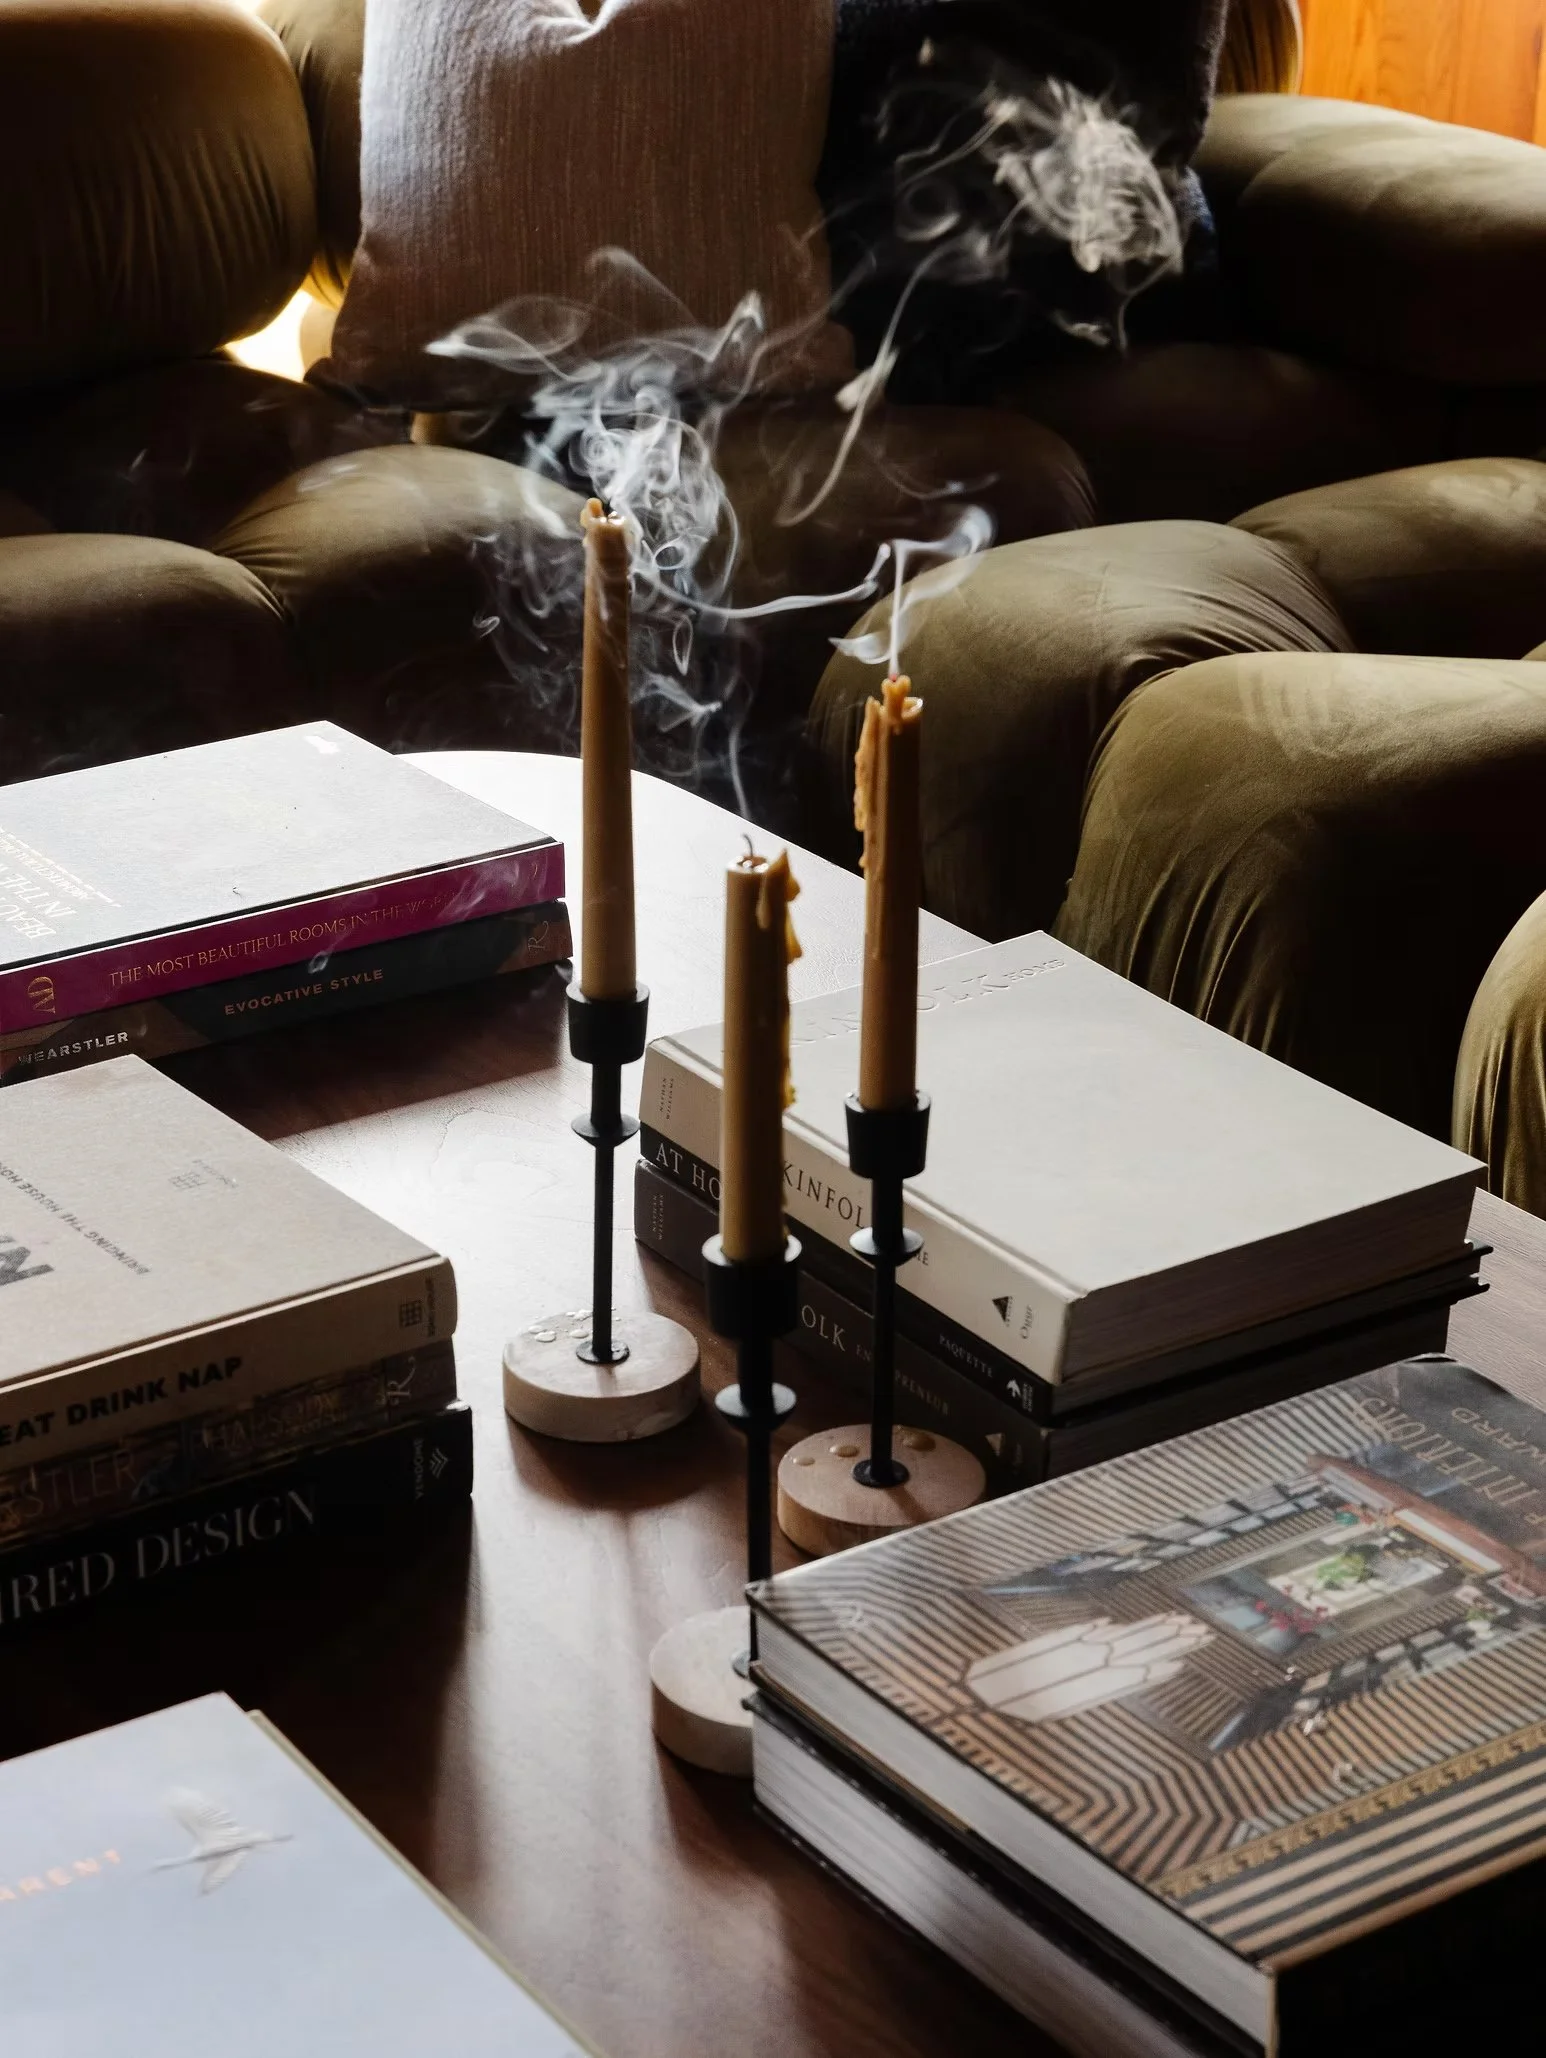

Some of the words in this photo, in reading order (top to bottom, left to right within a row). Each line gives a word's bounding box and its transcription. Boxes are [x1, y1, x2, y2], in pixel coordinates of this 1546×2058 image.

[109, 966, 144, 986] THE
[147, 954, 194, 977] MOST
[198, 932, 287, 967] BEAUTIFUL
[290, 918, 348, 947] ROOMS
[224, 984, 322, 1016] EVOCATIVE
[330, 968, 384, 991] STYLE
[18, 1031, 129, 1066] WEARSTLER
[656, 1142, 684, 1175] AT
[783, 1159, 866, 1230] KINFOL
[0, 1412, 55, 1446] EAT
[66, 1378, 169, 1426] DRINK
[178, 1356, 243, 1394] NAP
[136, 1487, 318, 1580] DESIGN
